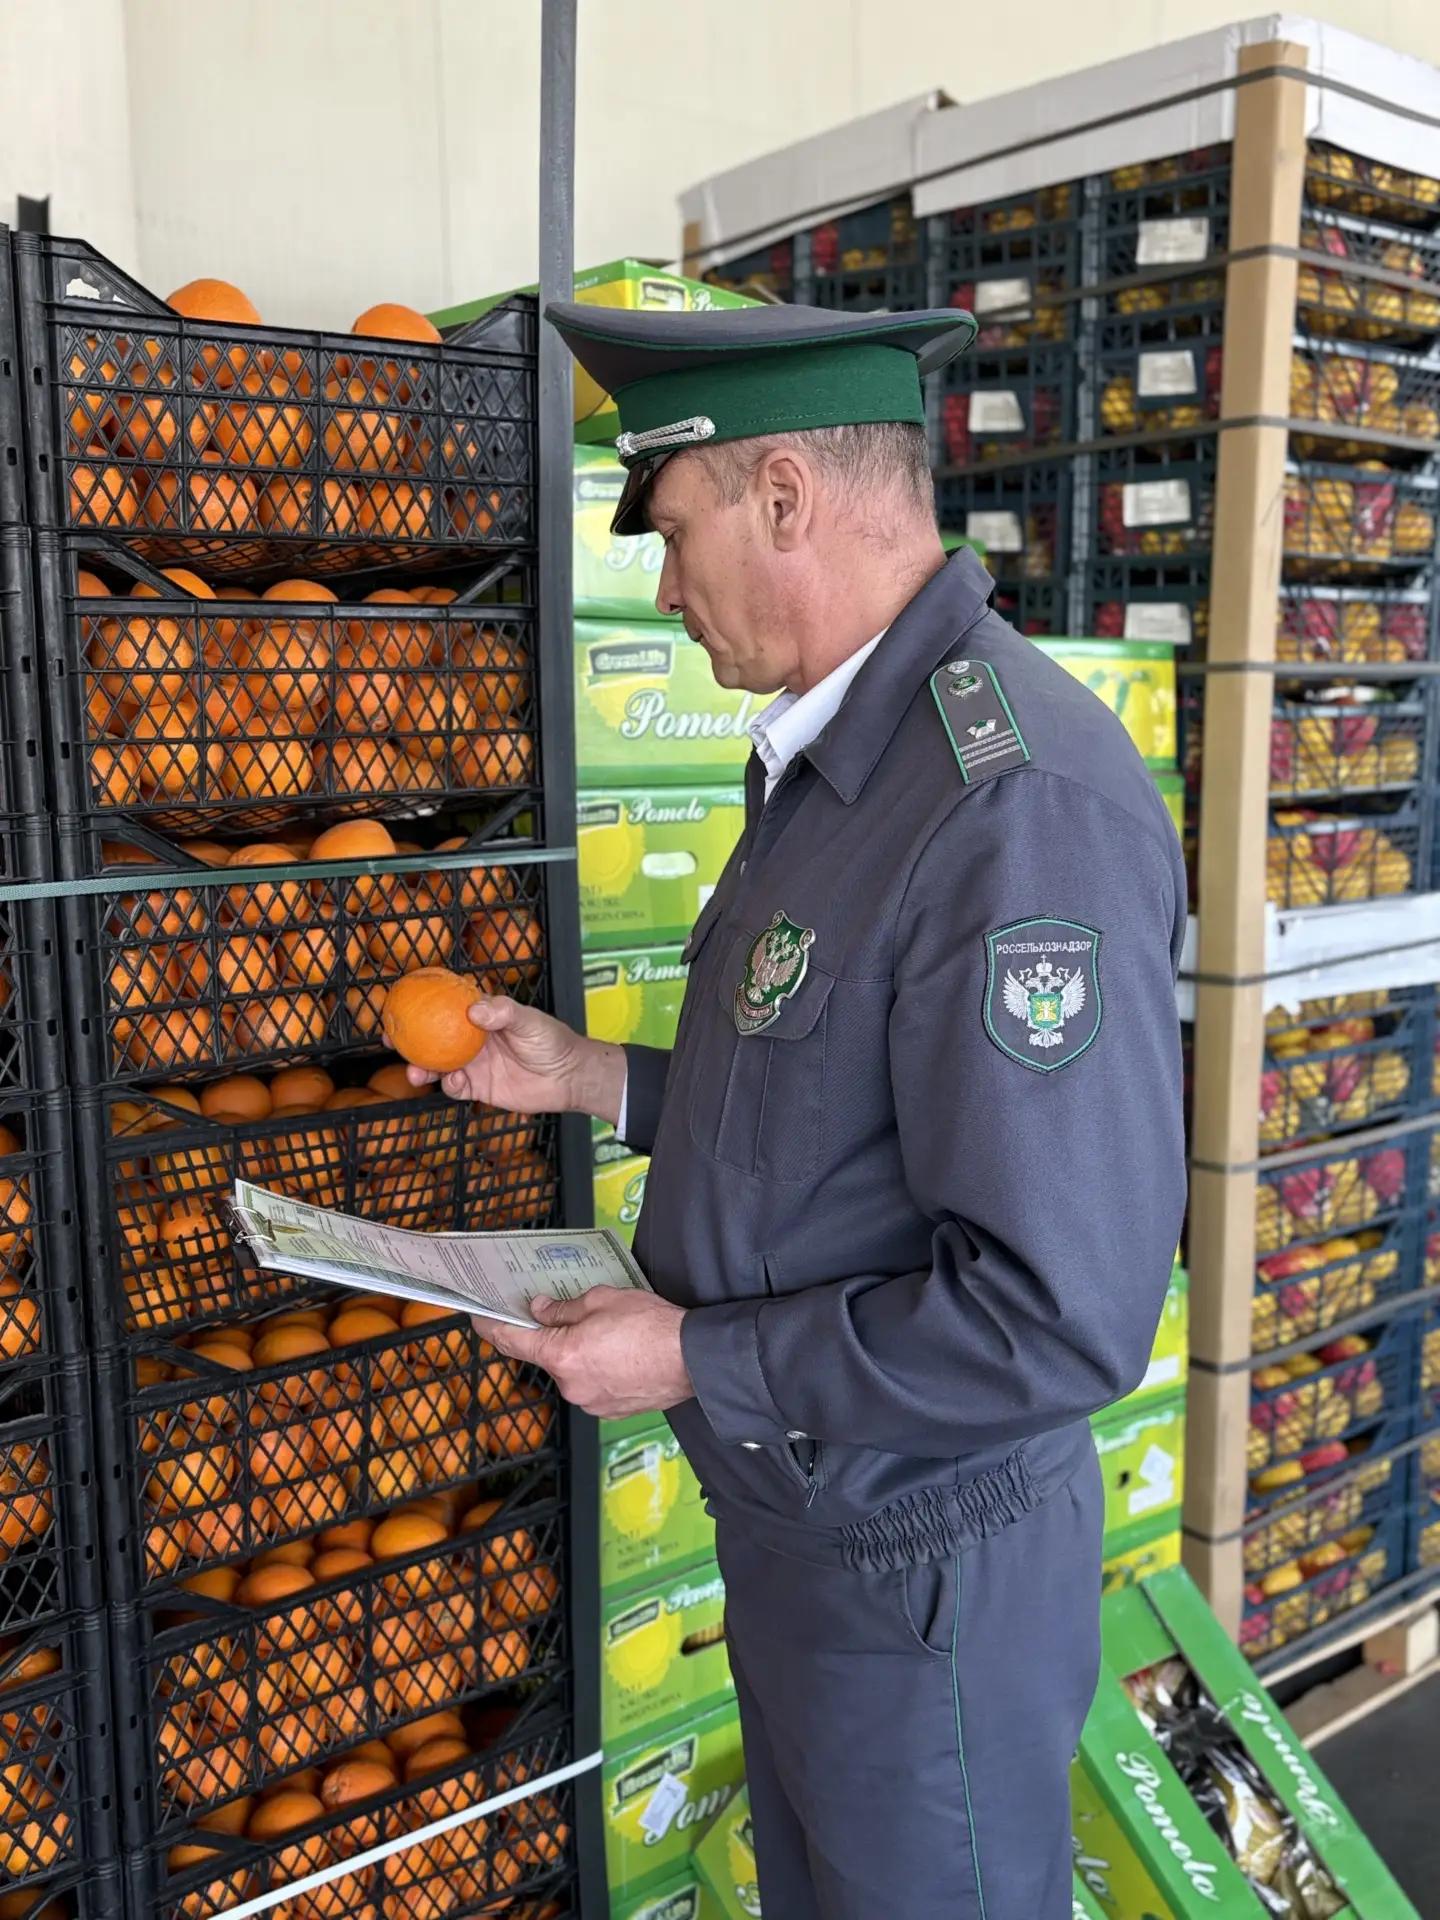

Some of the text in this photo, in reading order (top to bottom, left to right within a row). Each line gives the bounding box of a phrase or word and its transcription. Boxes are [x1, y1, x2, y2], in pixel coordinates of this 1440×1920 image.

[628, 797, 707, 823] Pomelo
[996, 941, 1092, 955] РОССЕЛЬХОЗНАДЗОР
[627, 956, 689, 984] Pome
[1238, 1688, 1338, 1826] Pomelo
[1116, 1752, 1220, 1902] Pomelo
